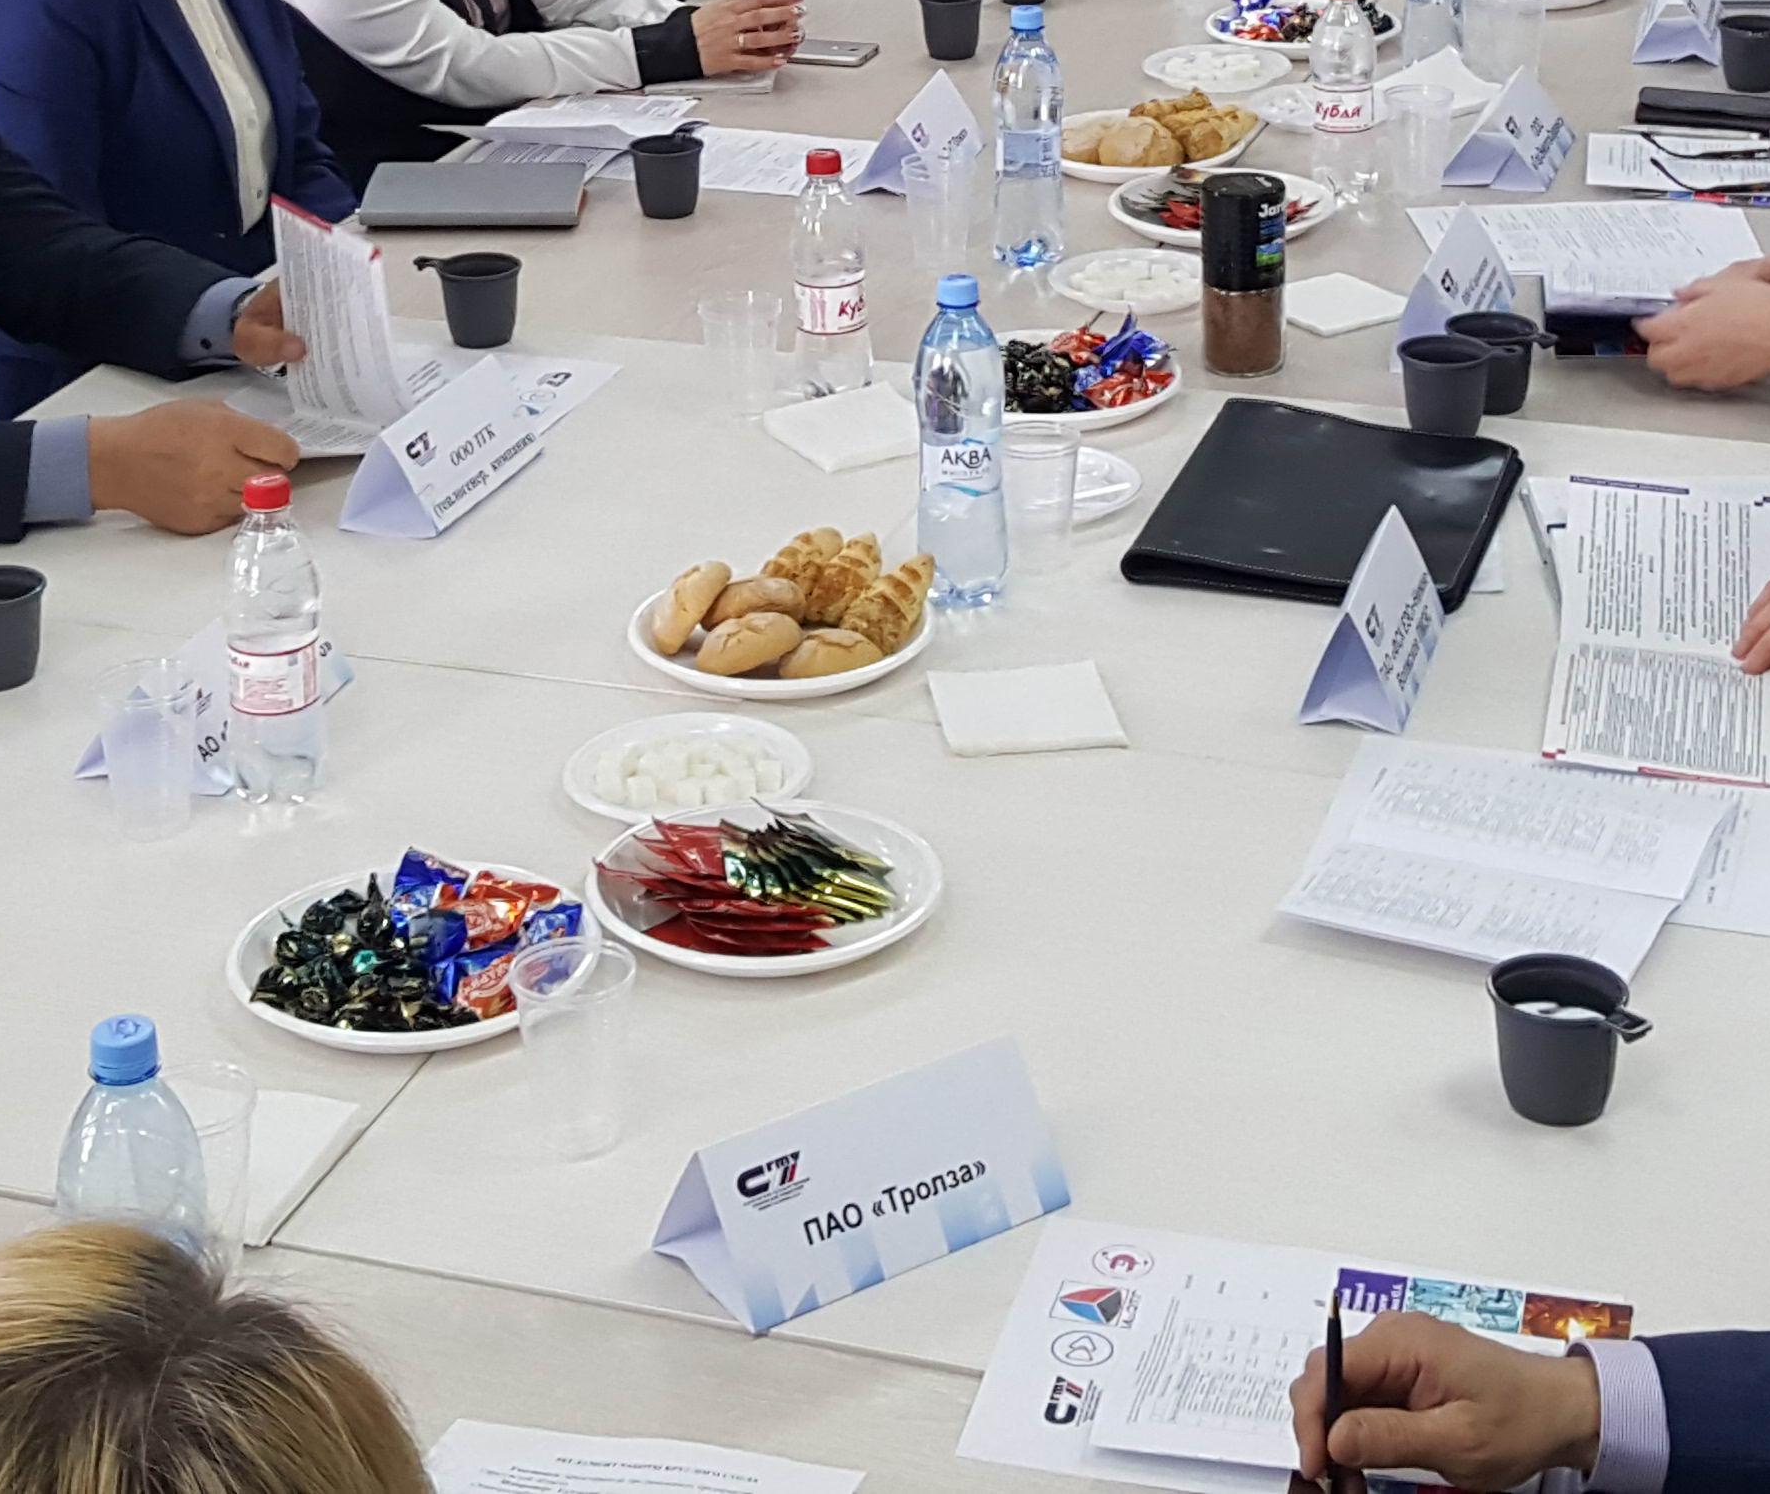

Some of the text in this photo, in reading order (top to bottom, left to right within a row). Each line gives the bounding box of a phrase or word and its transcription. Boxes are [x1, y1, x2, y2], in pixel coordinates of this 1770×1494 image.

[941, 446, 992, 470] АКВА
[802, 1201, 864, 1246] ПАО
[872, 1159, 987, 1217] «Тролза»
